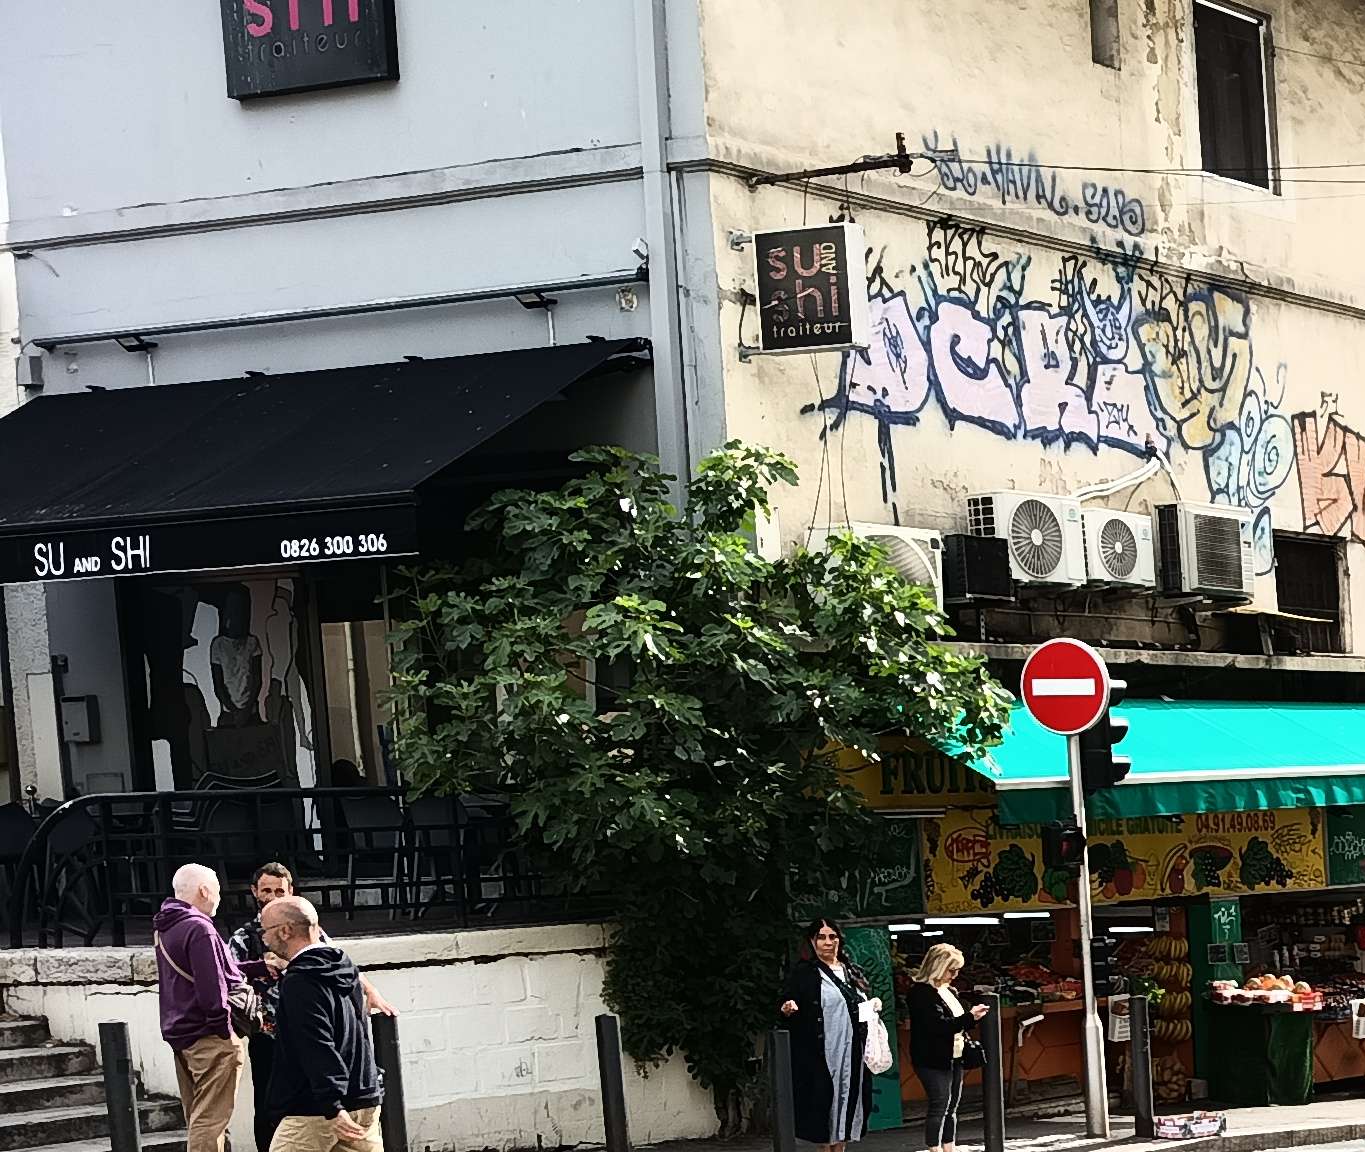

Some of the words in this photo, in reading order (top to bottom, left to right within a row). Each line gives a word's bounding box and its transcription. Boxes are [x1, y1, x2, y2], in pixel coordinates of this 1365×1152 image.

[821, 242, 837, 273] AND
[772, 321, 842, 338] traiteur
[34, 541, 65, 577] SU
[73, 555, 101, 574] AND
[110, 534, 150, 571] SHI
[280, 537, 320, 560] 0826
[323, 534, 354, 556] 300
[357, 532, 388, 554] 306
